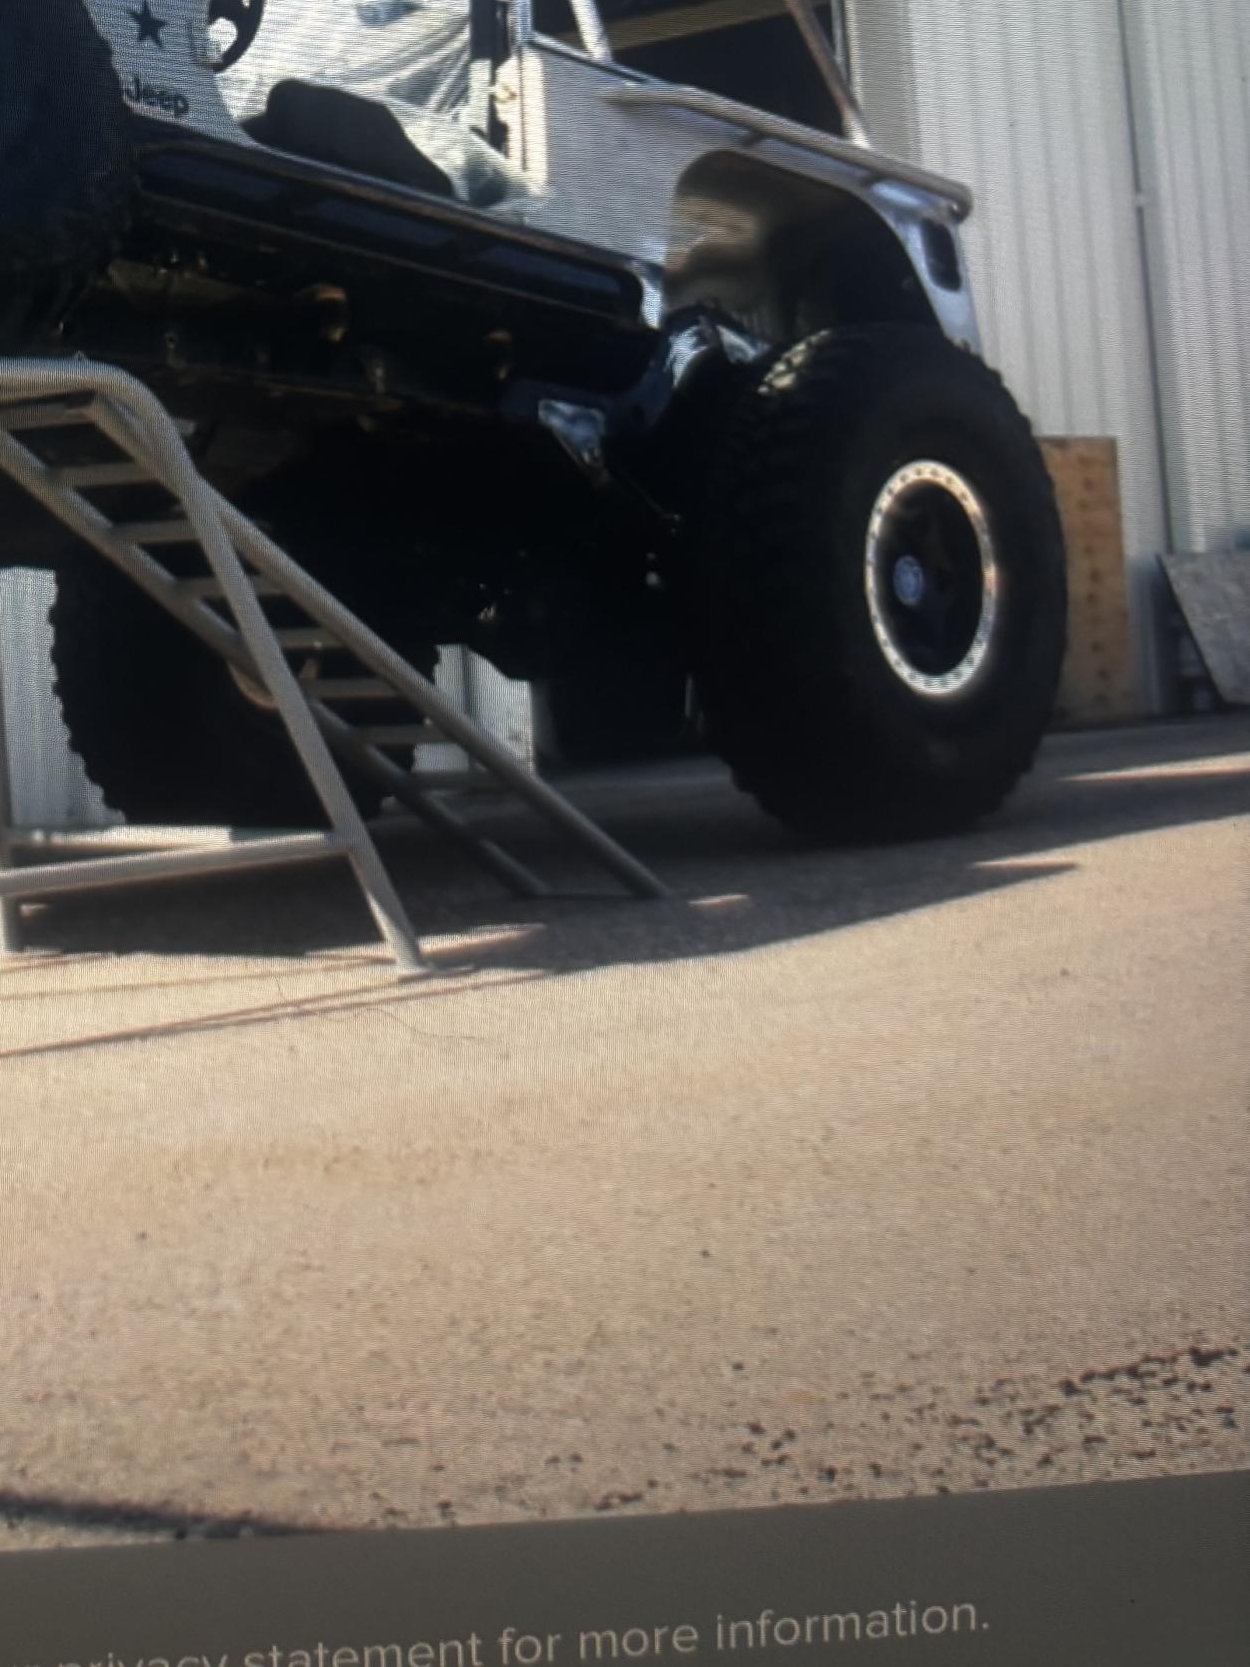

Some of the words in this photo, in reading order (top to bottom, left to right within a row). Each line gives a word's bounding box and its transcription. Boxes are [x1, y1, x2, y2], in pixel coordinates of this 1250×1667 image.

[125, 76, 190, 117] Jeep
[243, 1632, 482, 1667] statement
[498, 1626, 562, 1666] for
[579, 1624, 699, 1660] more
[716, 1599, 990, 1651] information.
